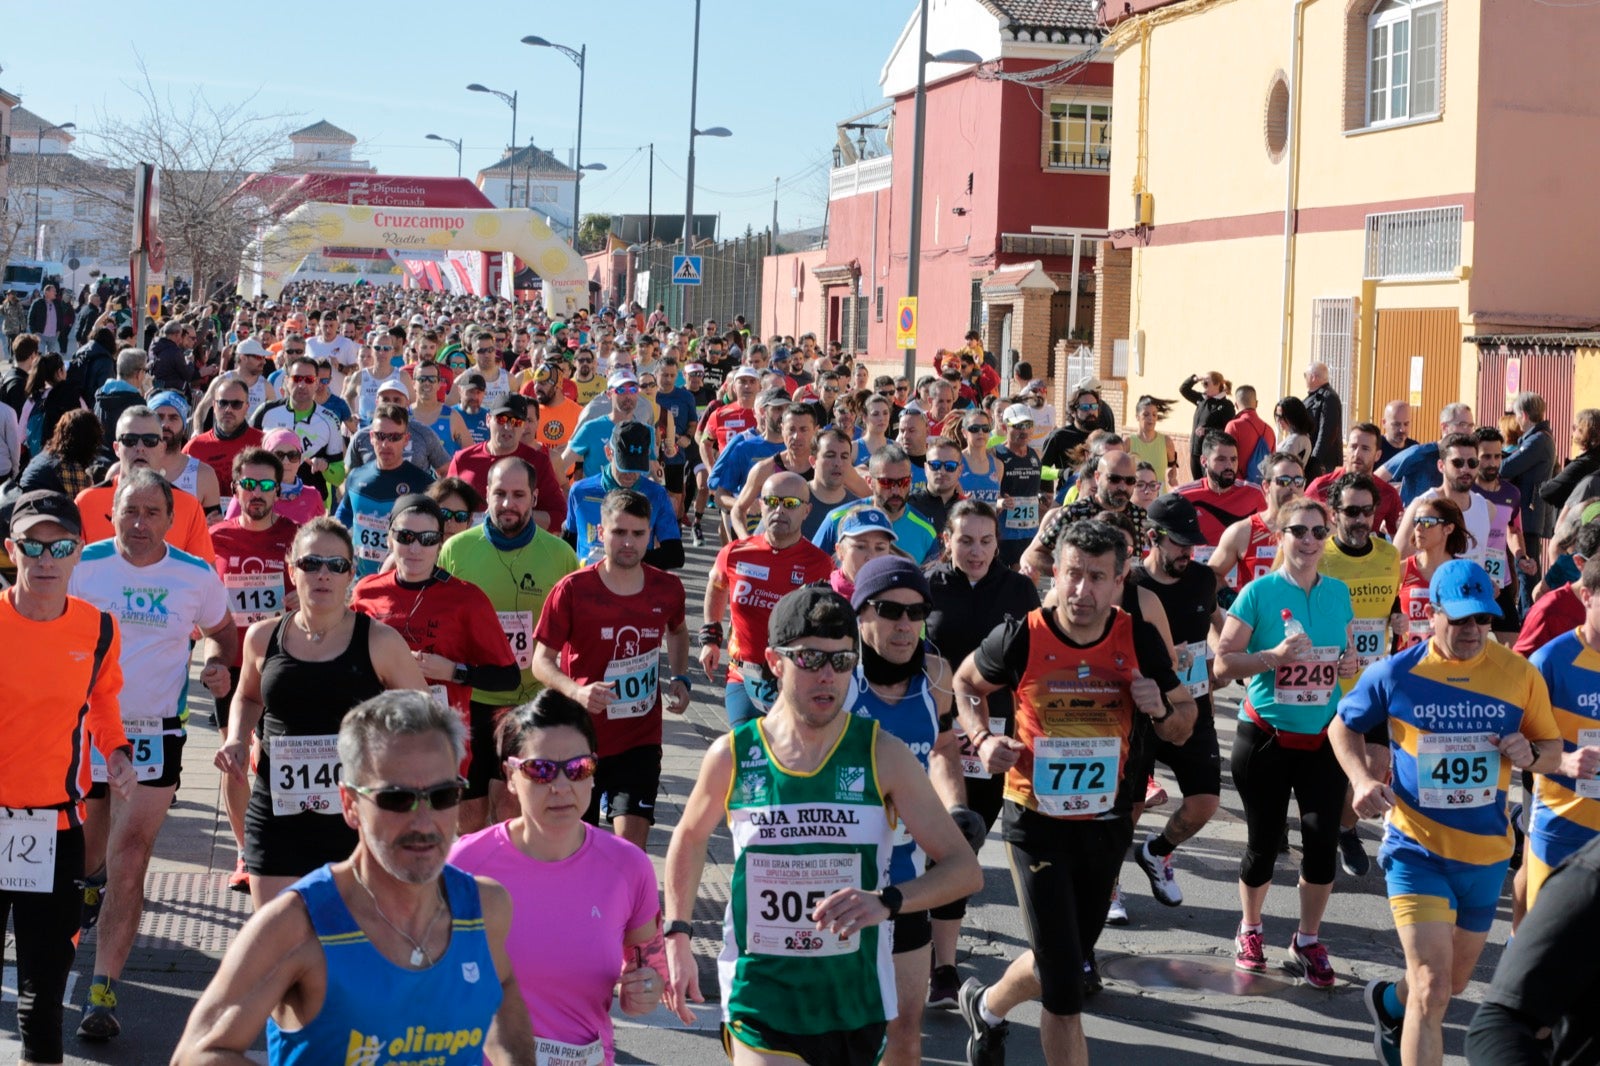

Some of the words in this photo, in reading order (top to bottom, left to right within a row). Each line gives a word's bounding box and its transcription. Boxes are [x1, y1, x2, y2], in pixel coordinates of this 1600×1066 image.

[372, 183, 426, 195] Diputación
[384, 196, 426, 206] Granada
[374, 212, 466, 231] Cruzcampo
[381, 231, 427, 244] Radler
[1013, 506, 1035, 519] 215
[1349, 582, 1393, 597] ustinos
[236, 589, 277, 610] 113
[1354, 634, 1379, 653] 89
[610, 666, 656, 700] 1014
[1278, 664, 1335, 686] 2249
[1413, 700, 1506, 724] agustinos
[1577, 693, 1600, 717] ag
[1428, 721, 1493, 730] GRANADA
[1048, 762, 1105, 791] 772
[1431, 756, 1488, 785] 495
[750, 810, 790, 826] CAJA
[797, 808, 860, 825] RURAL
[760, 828, 777, 839] DE
[780, 825, 848, 838] GRANADA
[766, 868, 801, 877] DIPUTACIÓN
[801, 869, 809, 877] DE
[811, 868, 839, 876] GRANADA
[771, 859, 790, 869] GRAN
[791, 859, 818, 869] PREMIO
[819, 859, 829, 868] DE
[829, 858, 853, 868] FONDO
[388, 1026, 483, 1056] olimpo
[540, 1042, 560, 1056] GRAN
